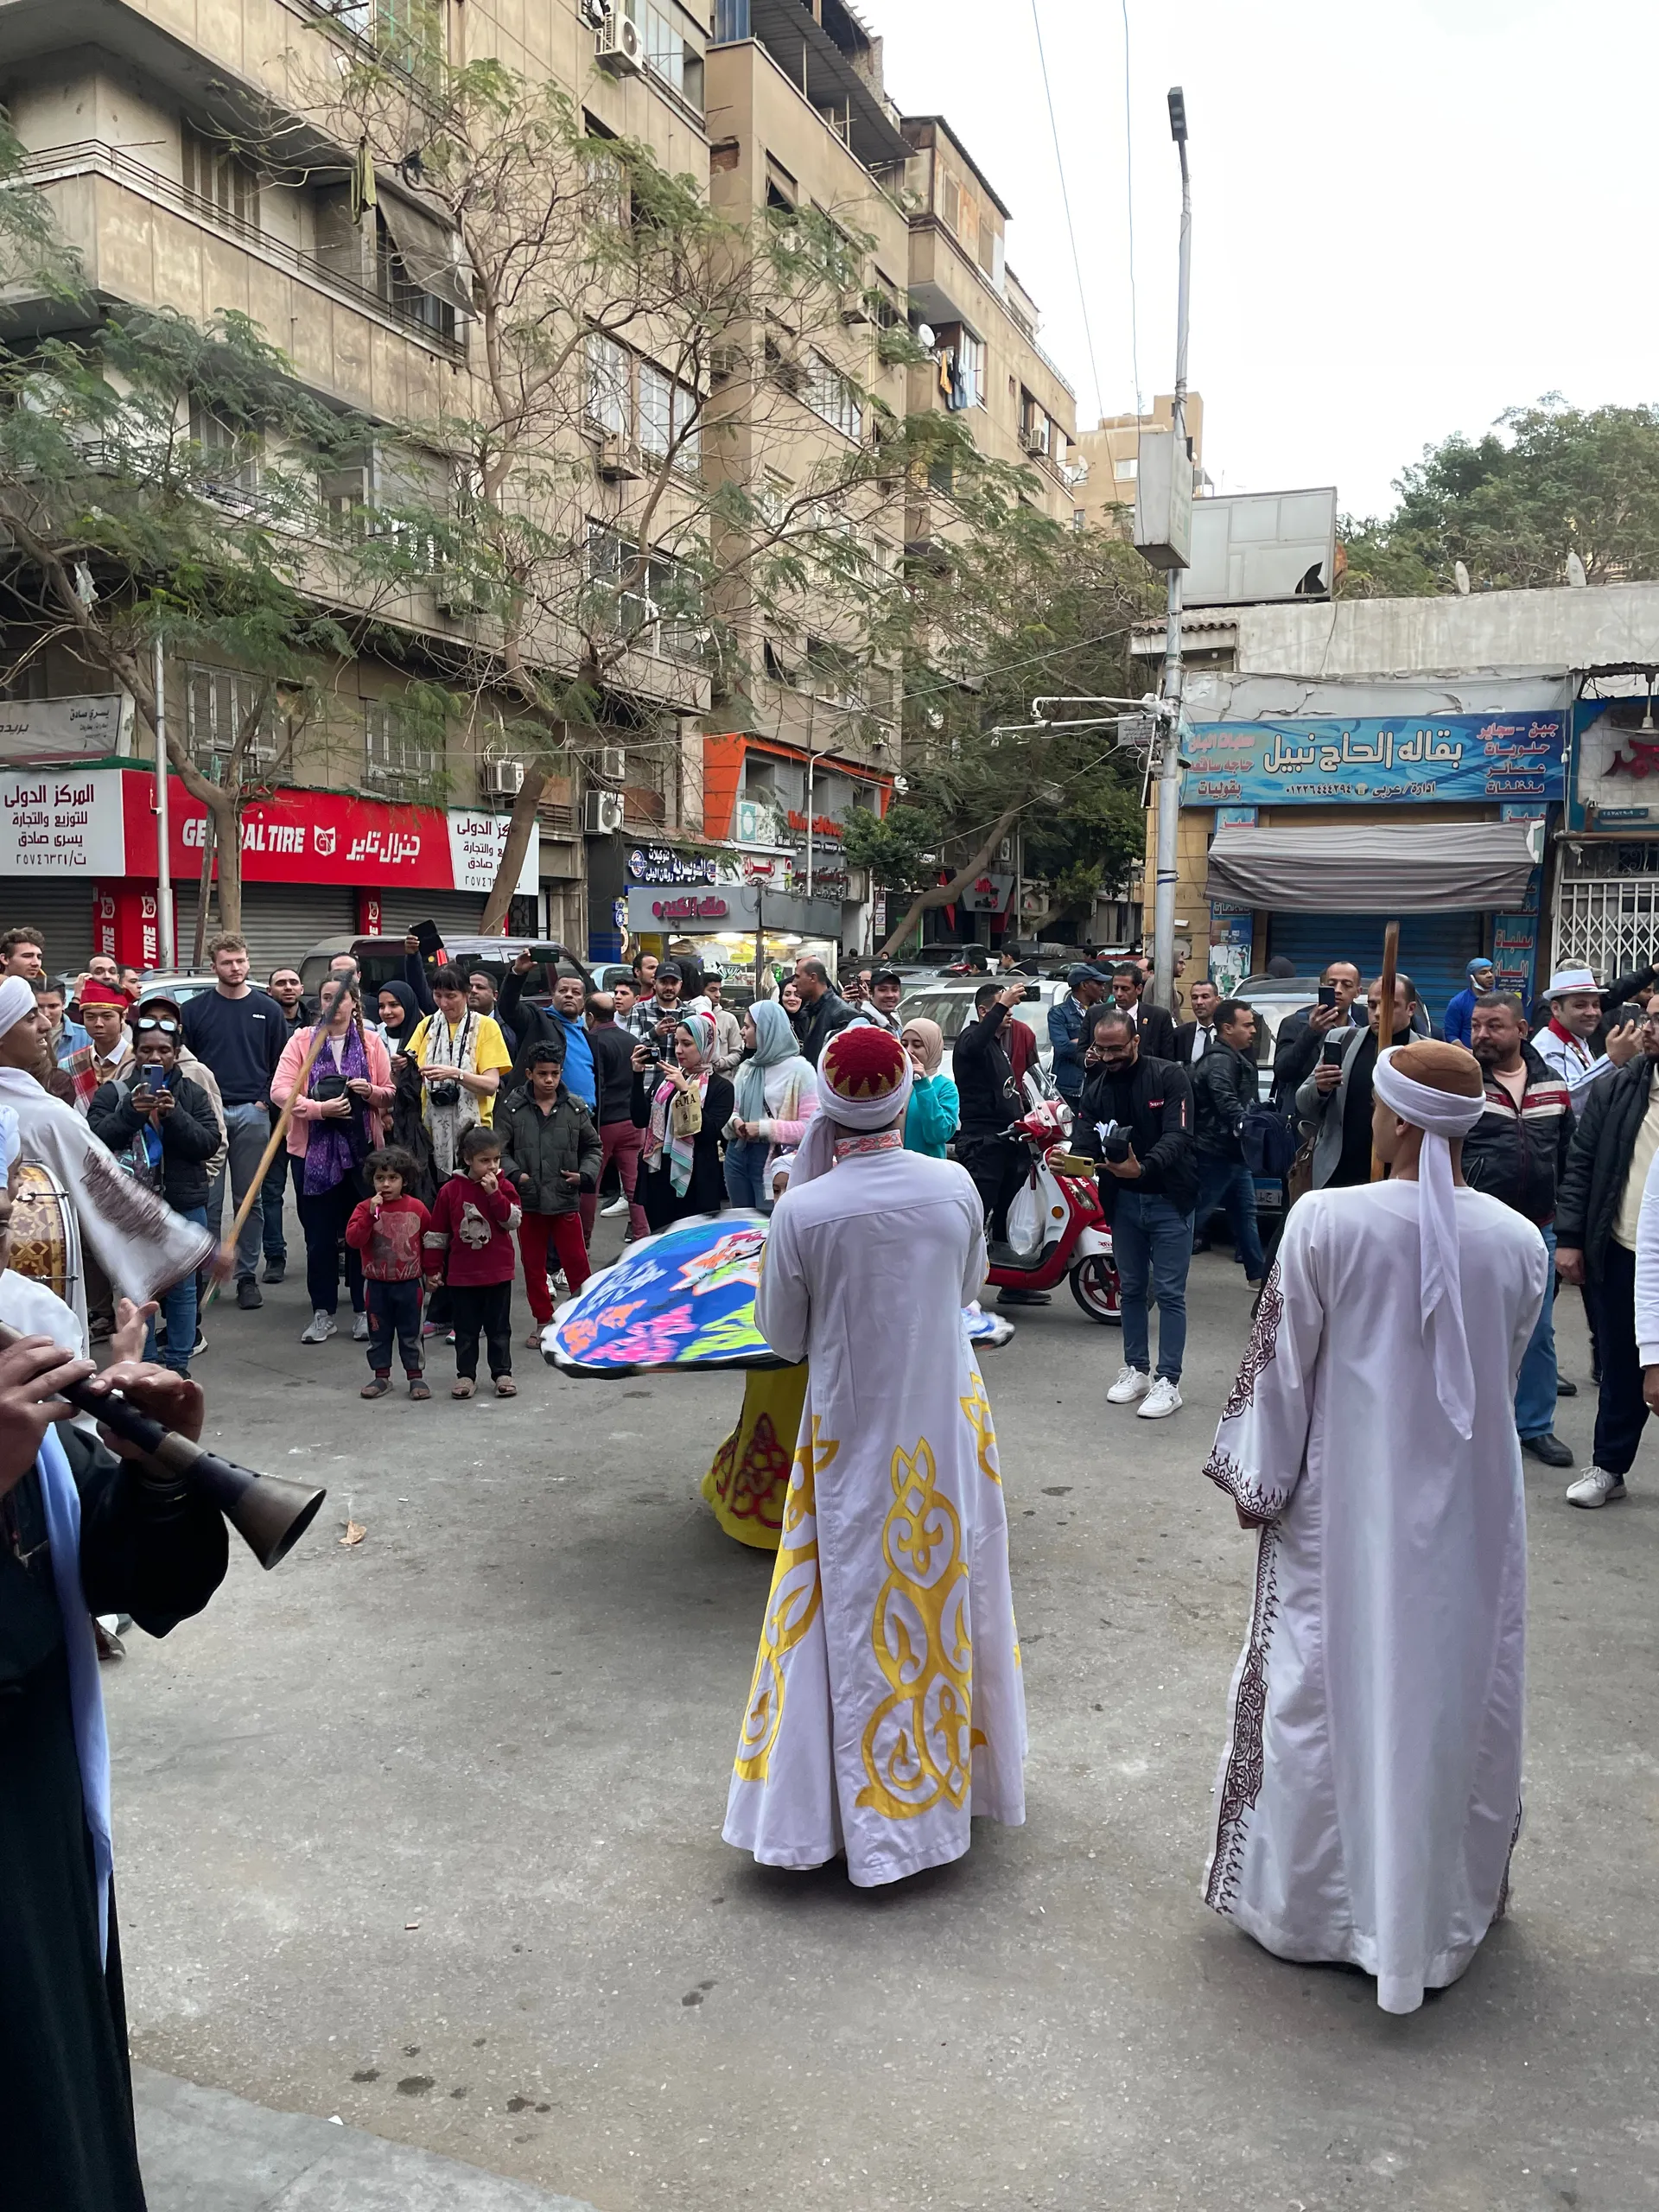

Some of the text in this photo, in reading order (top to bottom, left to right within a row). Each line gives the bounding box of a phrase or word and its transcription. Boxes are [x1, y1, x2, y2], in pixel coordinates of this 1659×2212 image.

[69, 709, 87, 721] صادق
[1476, 722, 1516, 741] سجاير
[1529, 721, 1559, 738] جبن
[1263, 729, 1463, 773] بقاله الحاج نبيل
[1484, 741, 1550, 759] حلويات
[1224, 757, 1255, 775] حاجه
[4, 784, 94, 808] المركز الدولى
[1198, 779, 1242, 801] بقوليات
[1485, 780, 1545, 794] منظفات
[12, 811, 87, 828] للتوزيع والتجارة
[457, 818, 492, 836] الدولى
[18, 831, 83, 847] يسرى صادق
[268, 825, 305, 853] TIRE
[346, 830, 421, 863] جنرال تاير
[463, 841, 493, 856] والتجارة
[467, 857, 493, 868] صادق
[102, 925, 116, 958] TIRE
[143, 925, 157, 959] TIRE
[1495, 930, 1534, 954] معلبات
